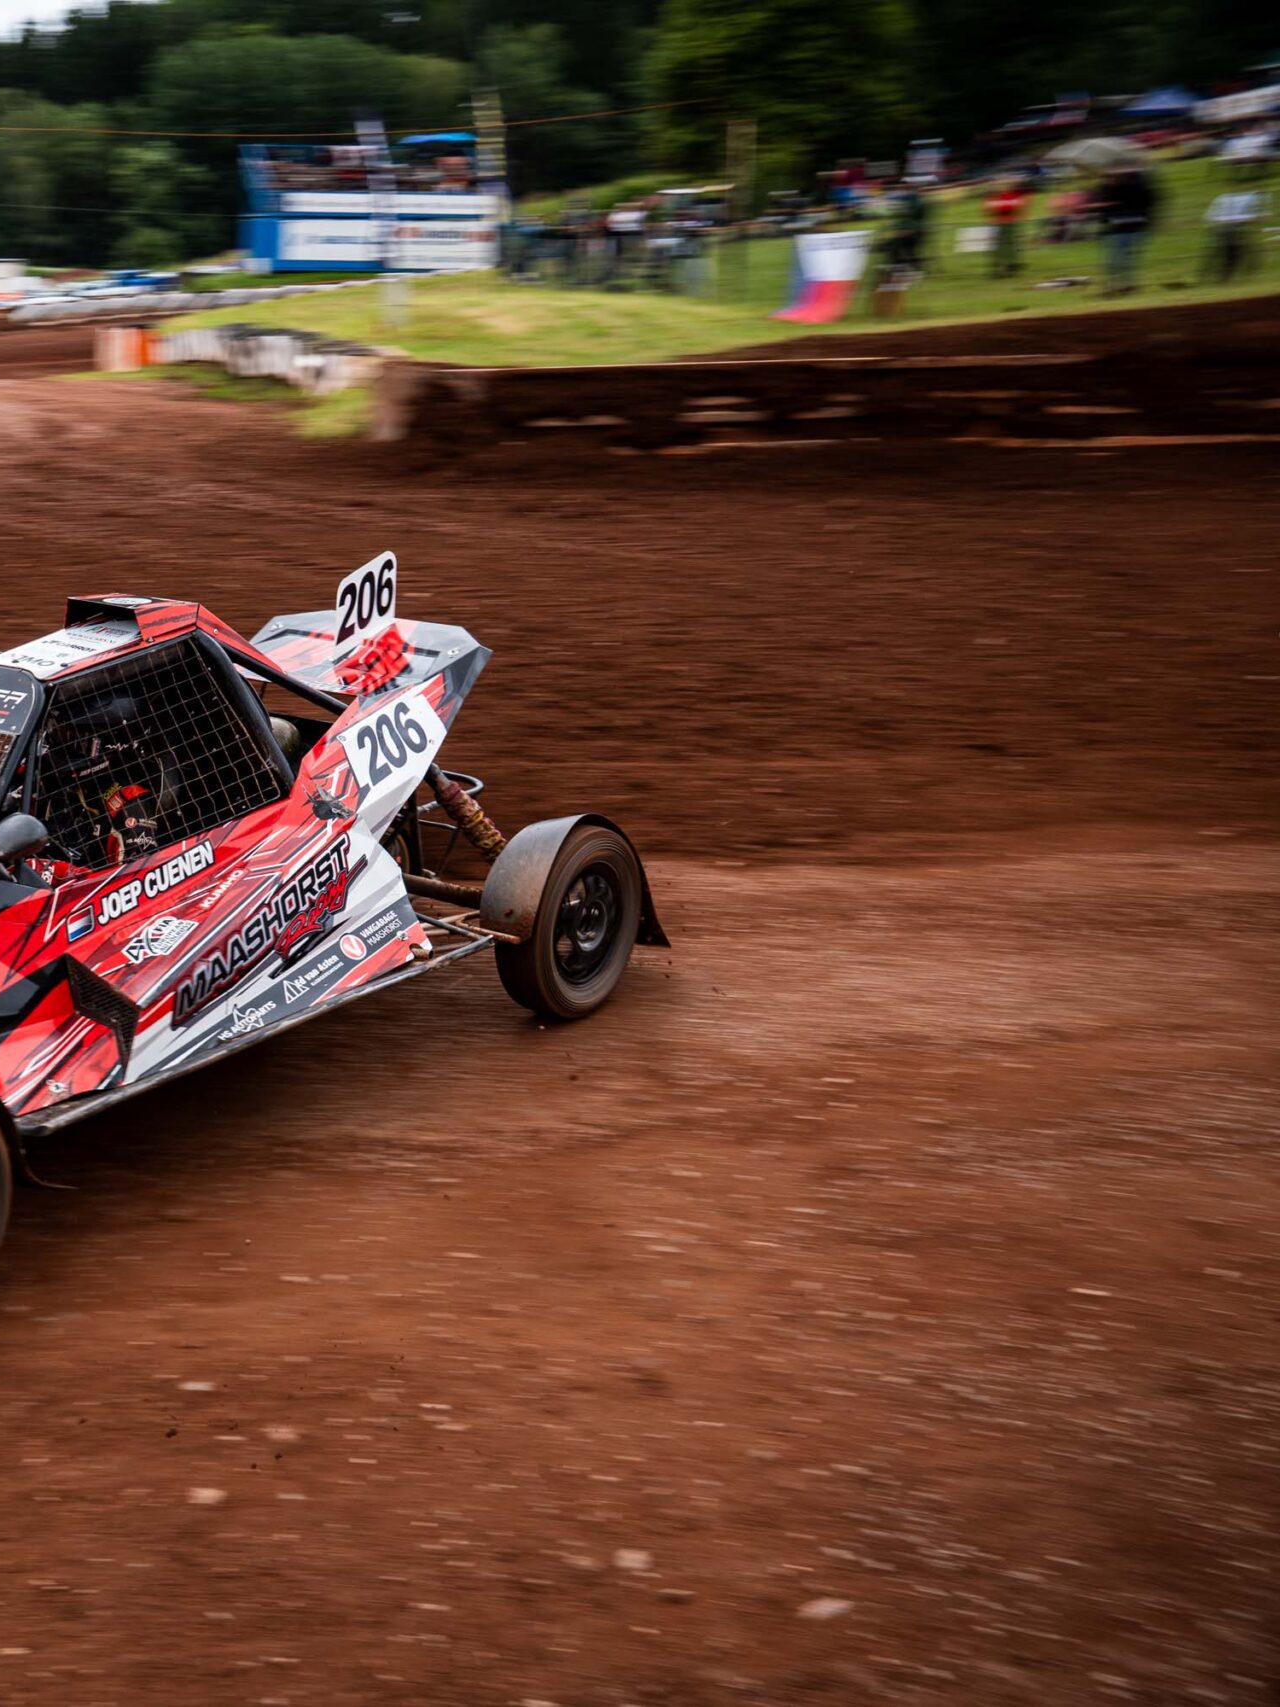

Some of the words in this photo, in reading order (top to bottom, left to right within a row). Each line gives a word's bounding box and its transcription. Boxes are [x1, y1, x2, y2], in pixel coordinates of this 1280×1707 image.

[336, 558, 395, 646] 206
[356, 701, 428, 787] 206
[97, 879, 142, 925] JOEP
[143, 840, 215, 899] CUENEN
[199, 868, 244, 909] KUMHO
[175, 836, 349, 1021] MAASHORST
[359, 910, 398, 938] VAKGARAGE
[366, 918, 403, 946] MAASHORST
[303, 968, 320, 981] van
[317, 954, 340, 971] Asten
[217, 1030, 233, 1041] HS
[230, 1000, 277, 1034] AUTOPARTS
